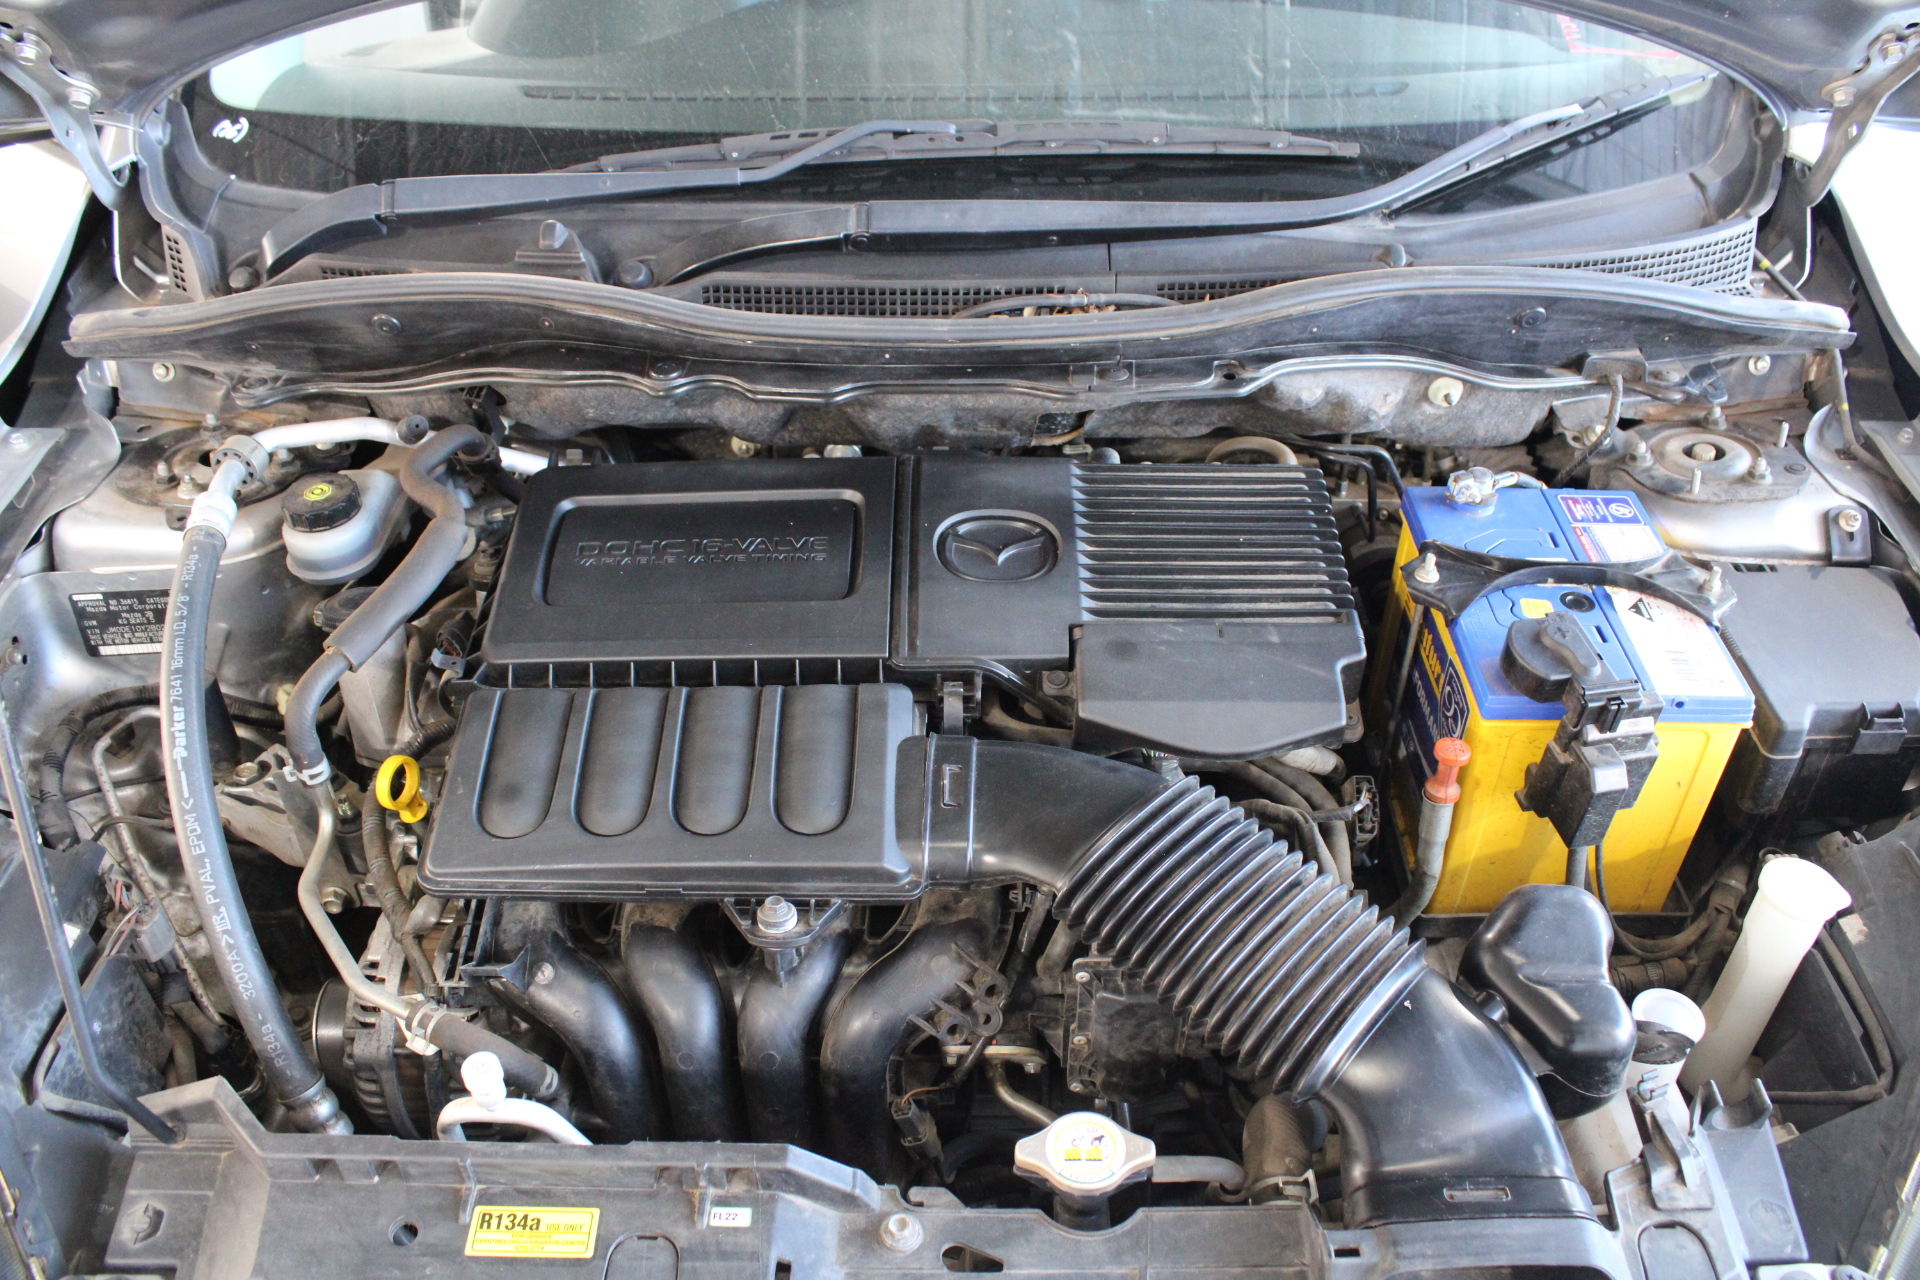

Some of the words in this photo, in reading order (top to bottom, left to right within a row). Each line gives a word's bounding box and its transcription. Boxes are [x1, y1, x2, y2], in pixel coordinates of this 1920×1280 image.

[575, 555, 676, 566] VARIABLE
[682, 555, 747, 564] VALVE
[751, 553, 826, 563] TIMING
[576, 539, 686, 556] DOHC
[692, 537, 828, 552] 16-VALVE
[181, 554, 199, 580] R134a
[170, 638, 188, 671] 16mm
[170, 674, 183, 703] 7641
[171, 705, 188, 759] Parker
[184, 813, 207, 856] EPDM
[227, 949, 256, 1000] 3200A
[261, 1023, 289, 1067] R134a
[479, 1212, 541, 1231] R134a
[546, 1223, 561, 1232] USE
[563, 1223, 584, 1232] ONLY
[713, 1212, 738, 1221] FL22
